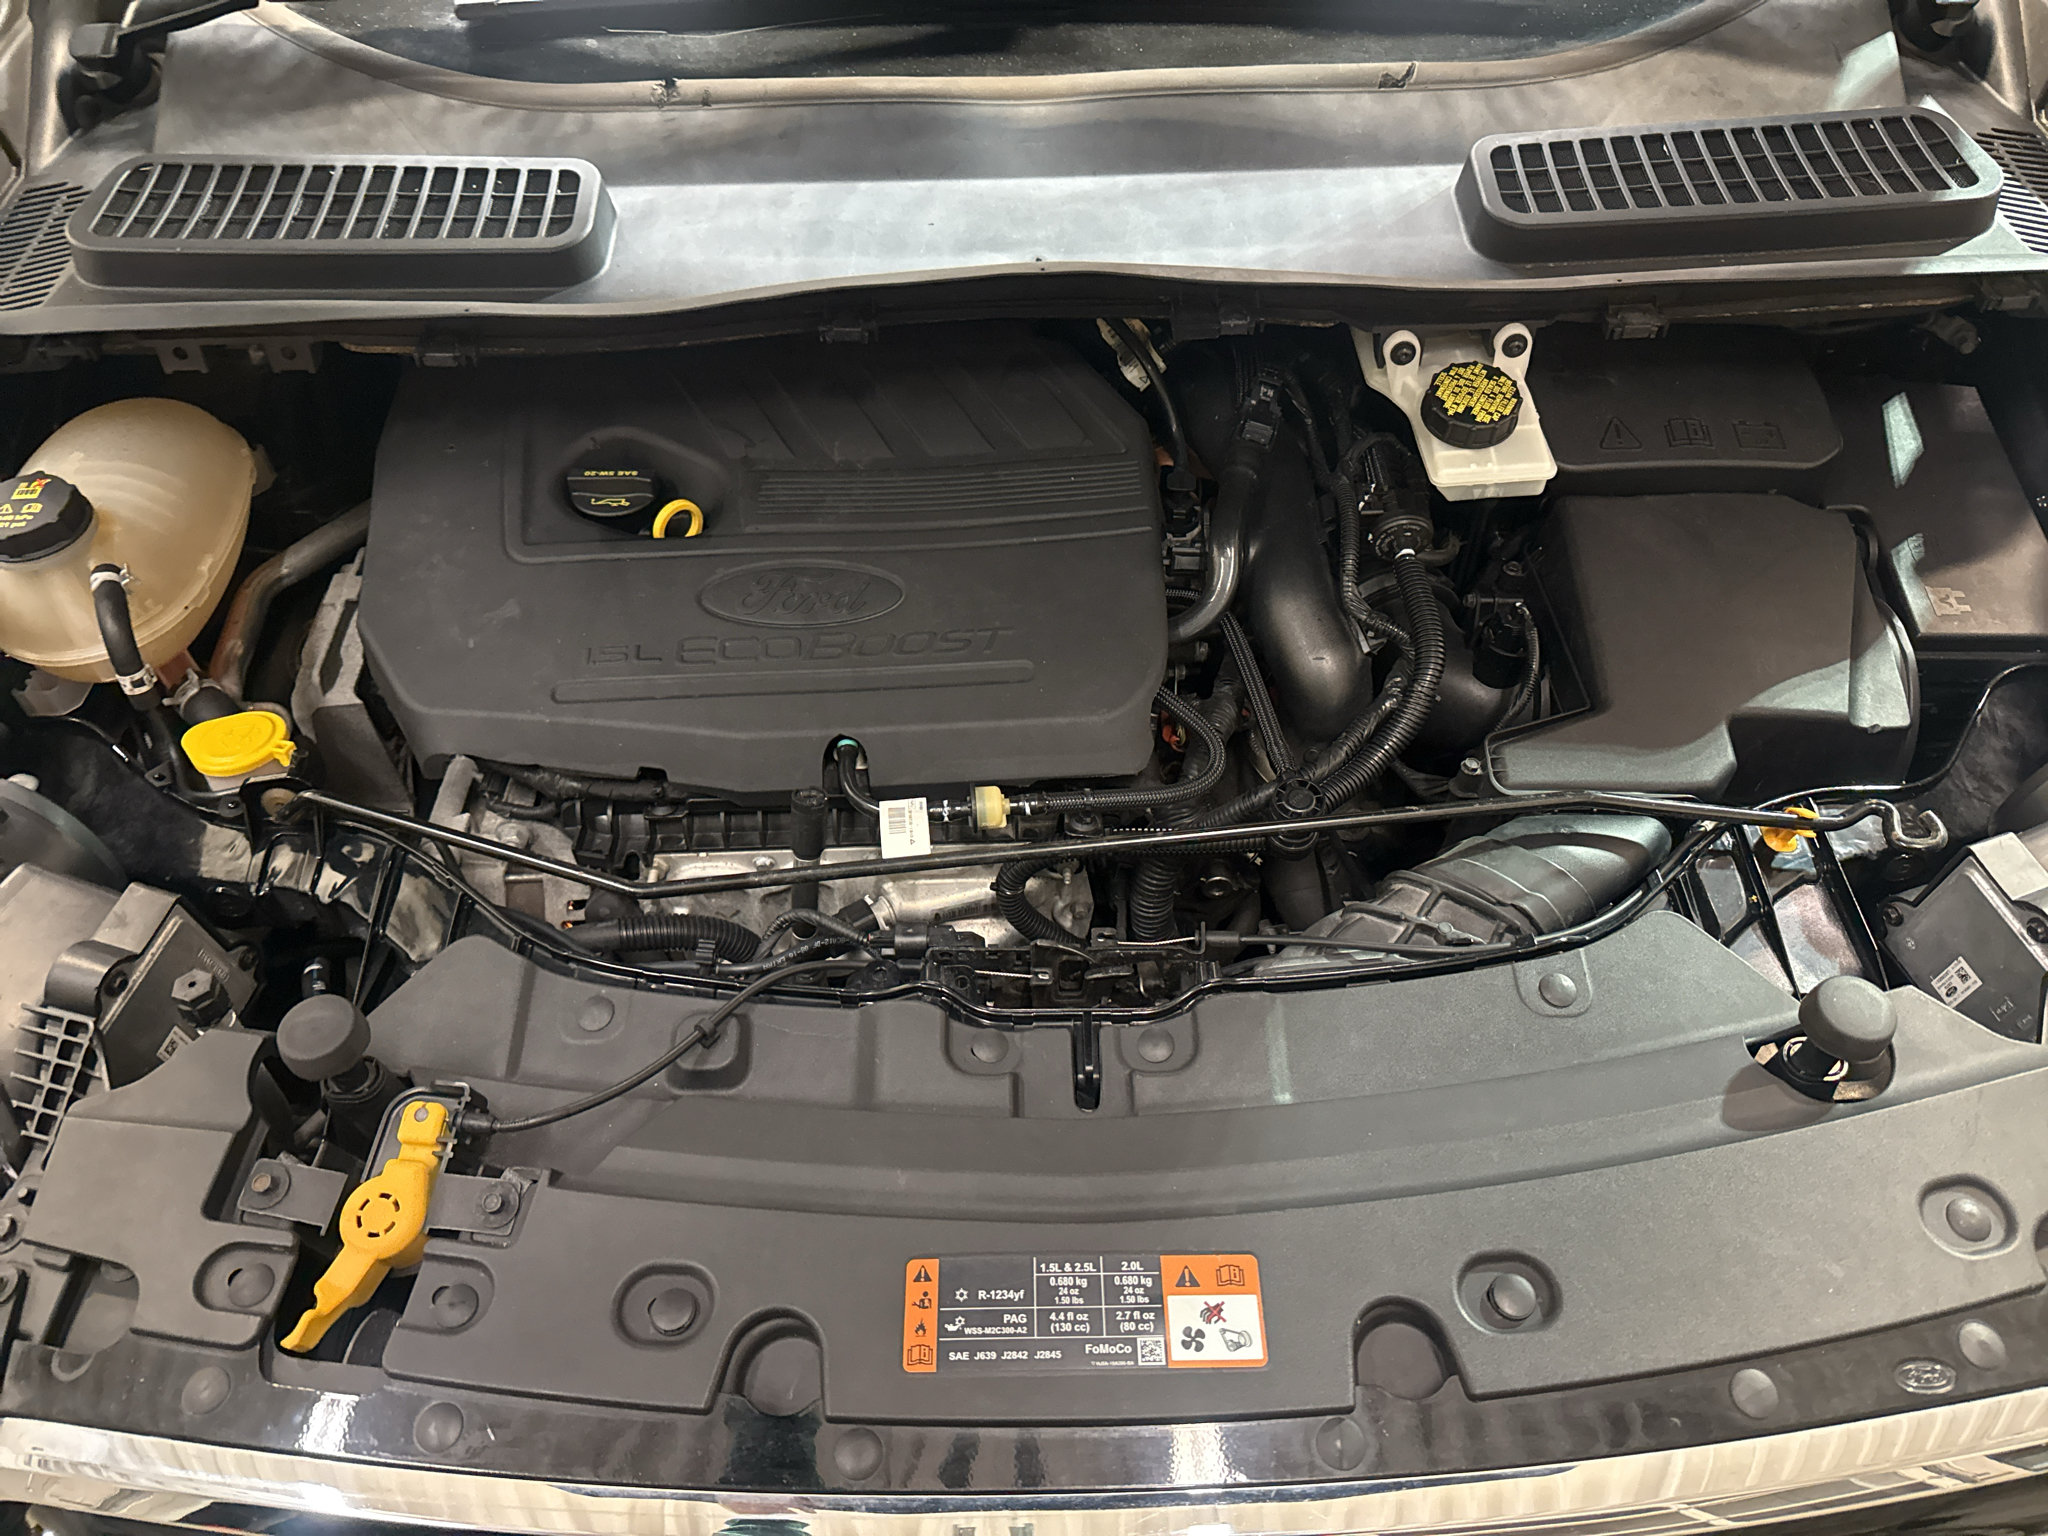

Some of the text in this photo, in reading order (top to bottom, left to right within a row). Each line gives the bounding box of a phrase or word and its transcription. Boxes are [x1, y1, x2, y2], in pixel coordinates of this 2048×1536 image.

[738, 567, 871, 616] Ford
[585, 644, 663, 665] 1.5L
[1040, 1262, 1097, 1272] 1.5L & 2.5L
[1121, 1261, 1144, 1271] 2.0L
[1049, 1276, 1088, 1288] 0.680 kg
[1114, 1276, 1152, 1287] 0.680 kg
[1058, 1287, 1068, 1295] 24
[1123, 1286, 1133, 1294] 24
[978, 1289, 1025, 1302] R-1234yf
[1054, 1296, 1084, 1304] 1.50 lbs
[1119, 1295, 1149, 1304] 1.50 lbs
[1003, 1314, 1028, 1324] PAG
[1049, 1312, 1089, 1321] 4.4 fl oz
[1115, 1311, 1155, 1320] 2.7 fl oz
[1050, 1322, 1090, 1334] (130 cc)
[1120, 1321, 1154, 1333] (80 cc)
[1084, 1343, 1132, 1354] FoMoCo
[948, 1350, 1062, 1361] SAE J639 J2842 J2845
